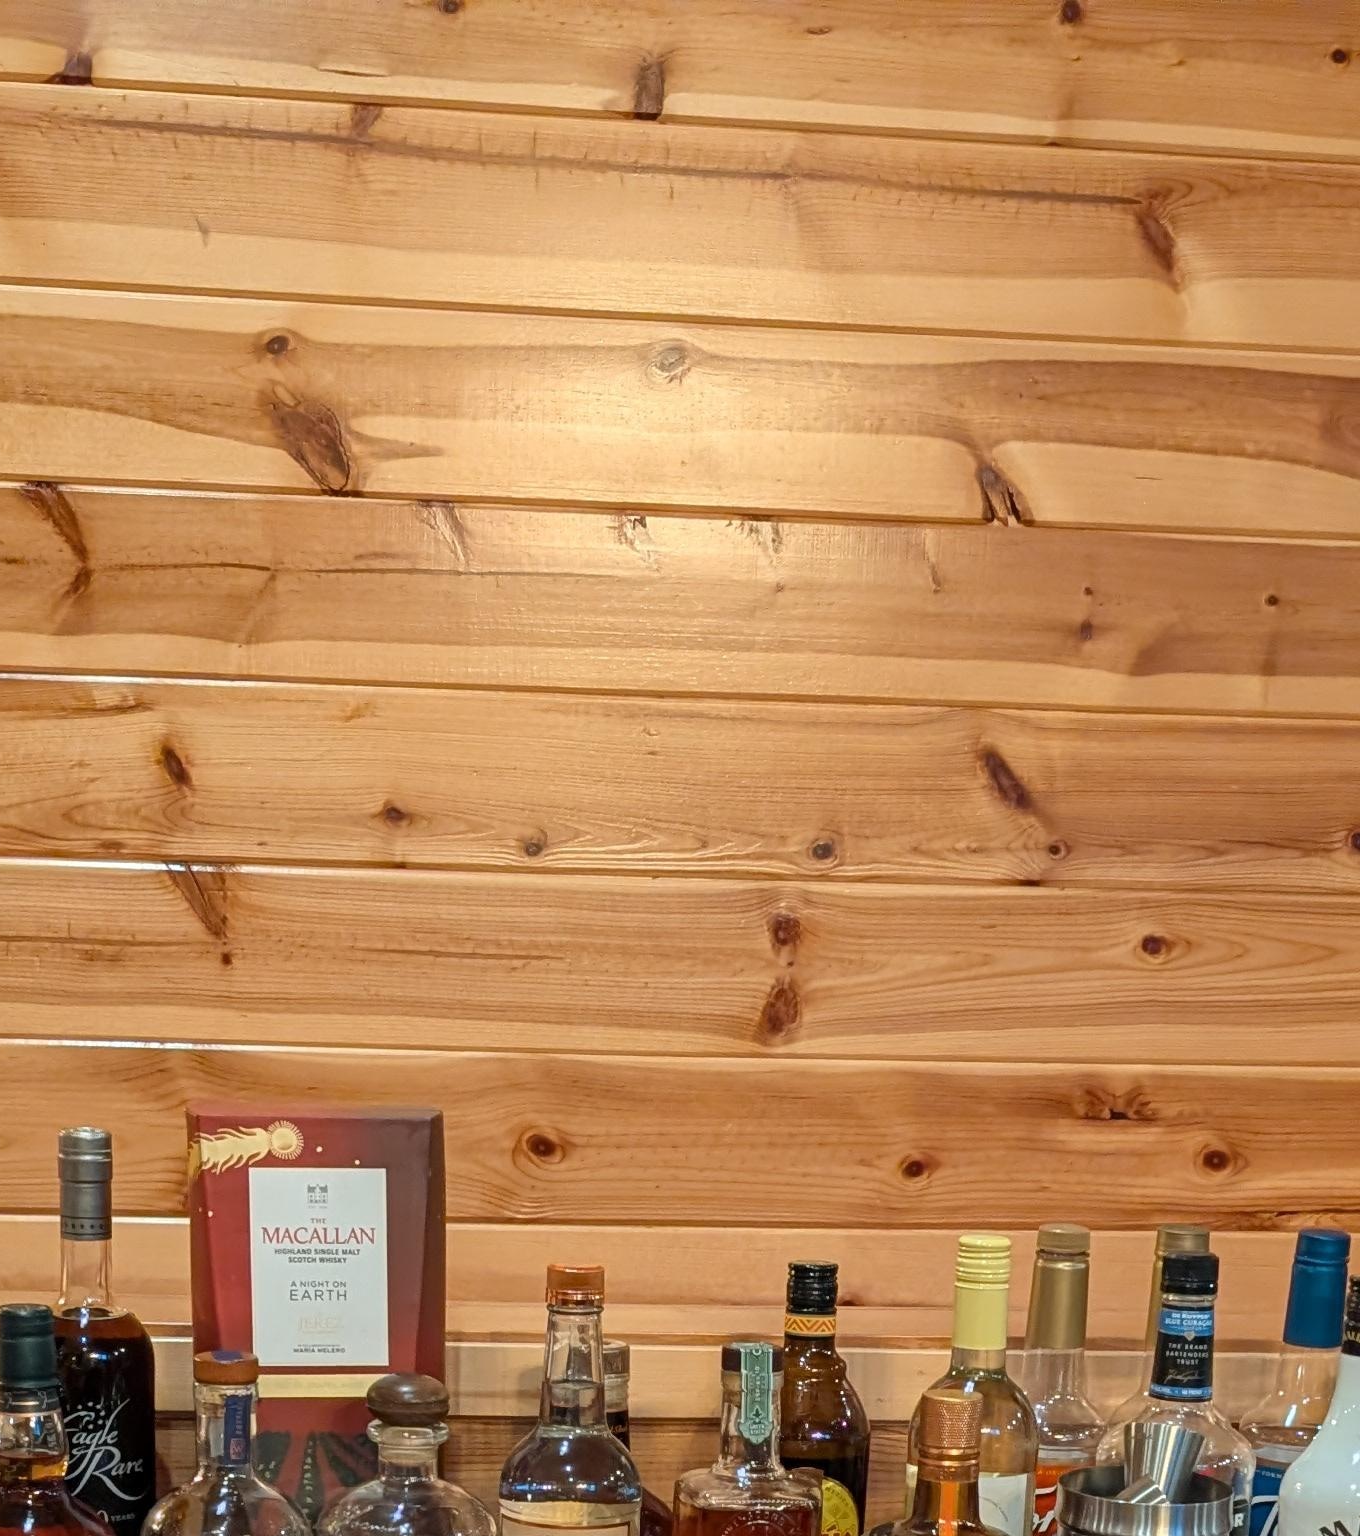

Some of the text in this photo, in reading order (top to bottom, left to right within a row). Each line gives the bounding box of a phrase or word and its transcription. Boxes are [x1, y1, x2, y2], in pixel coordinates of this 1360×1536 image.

[261, 1226, 376, 1245] MACALLAN
[341, 1248, 361, 1256] MALT
[289, 1289, 348, 1301] EARTH
[71, 1445, 147, 1500] Rare
